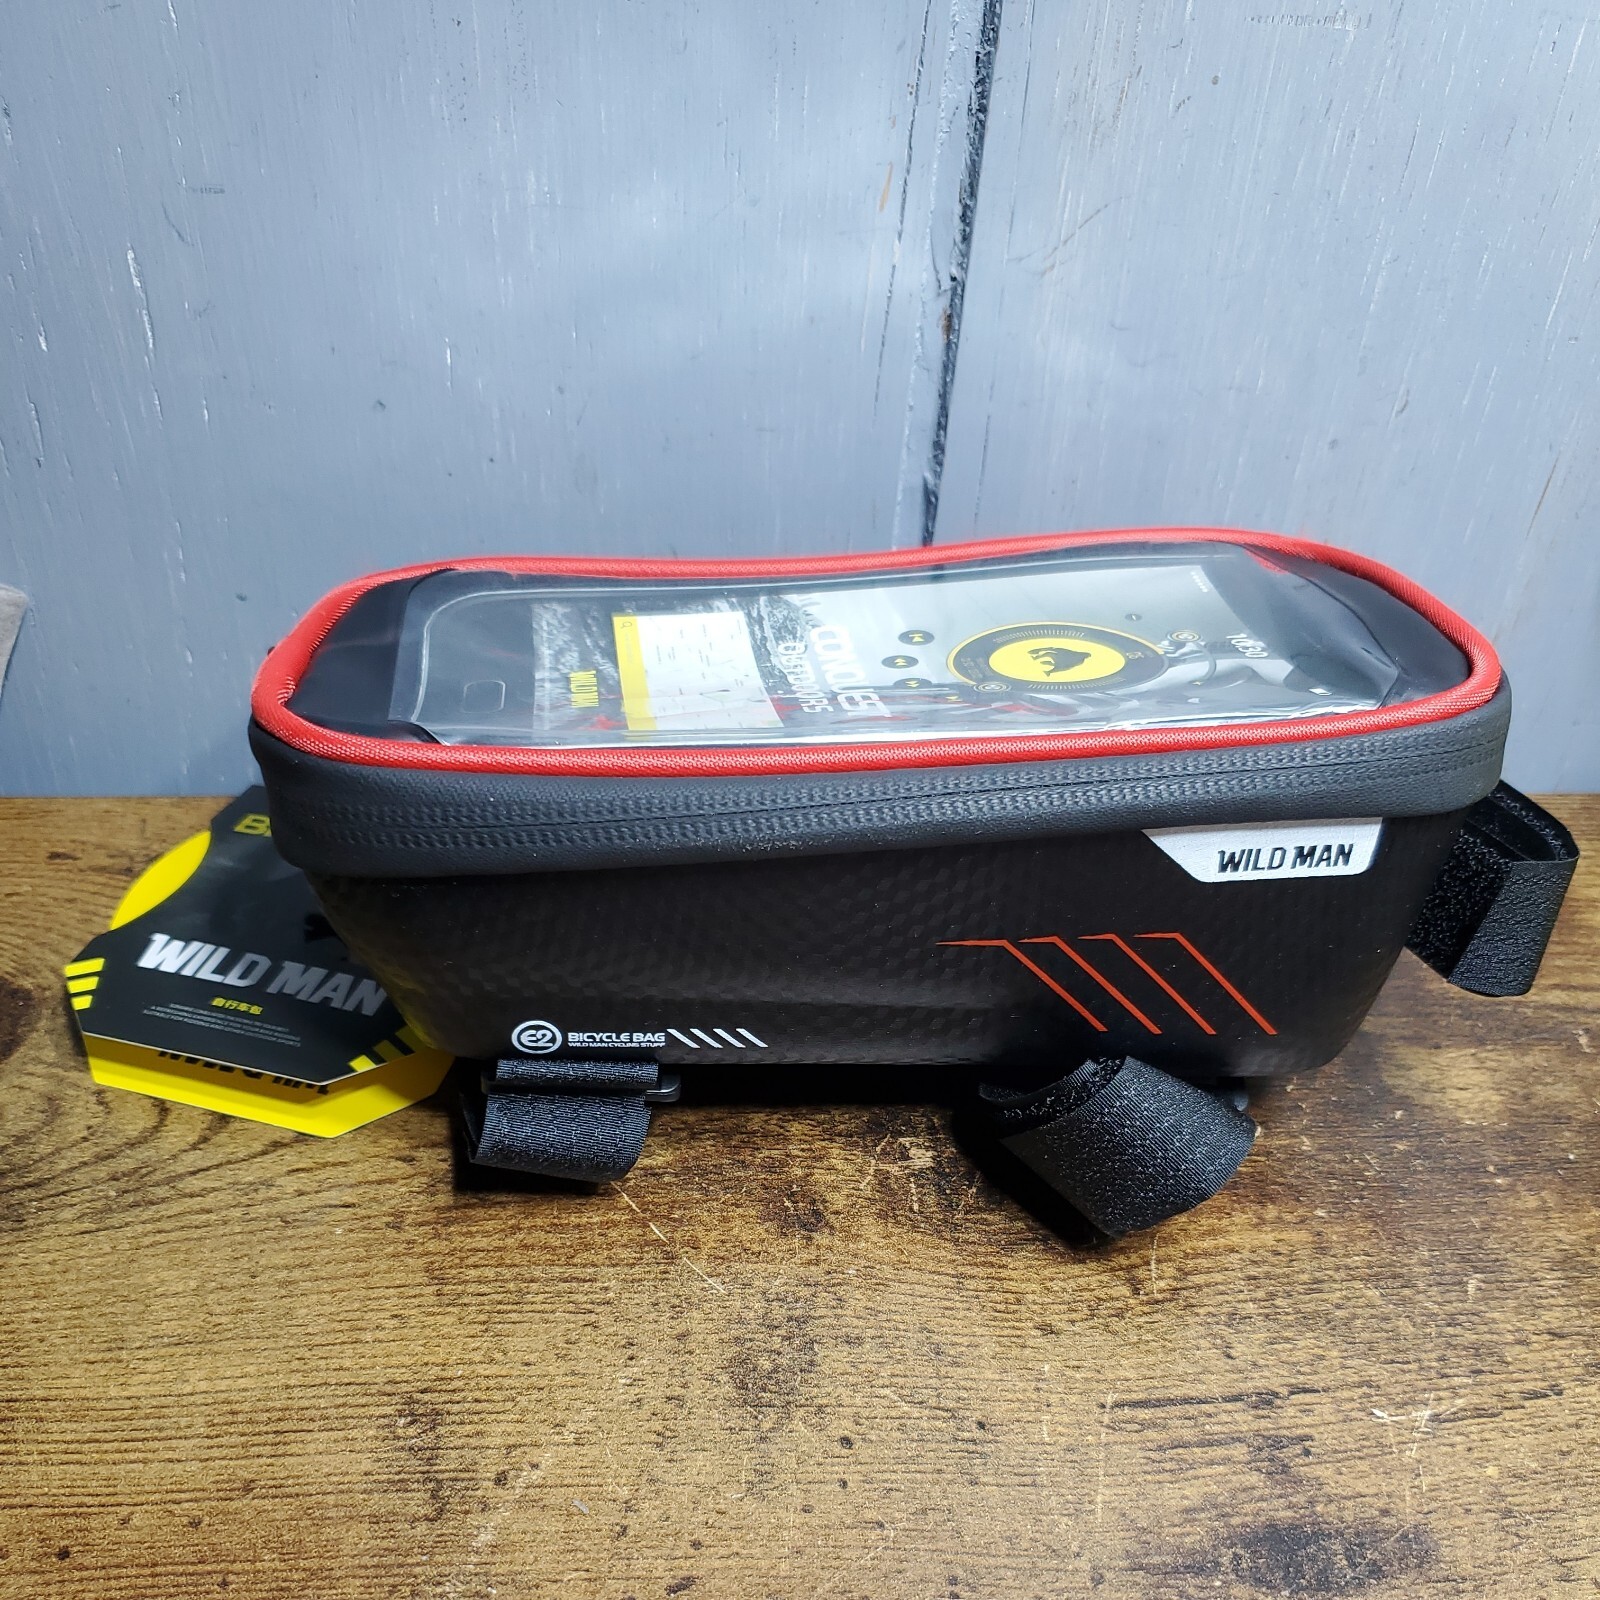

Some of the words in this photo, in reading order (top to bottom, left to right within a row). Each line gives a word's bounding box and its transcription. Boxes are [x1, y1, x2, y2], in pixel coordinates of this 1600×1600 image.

[809, 624, 893, 718] CONQUEST
[1218, 847, 1287, 873] WILD
[1290, 844, 1354, 869] MAN
[137, 932, 273, 988] WILD
[266, 960, 388, 1016] MAN
[568, 1032, 630, 1042] BICYCLE
[633, 1032, 665, 1042] BAG
